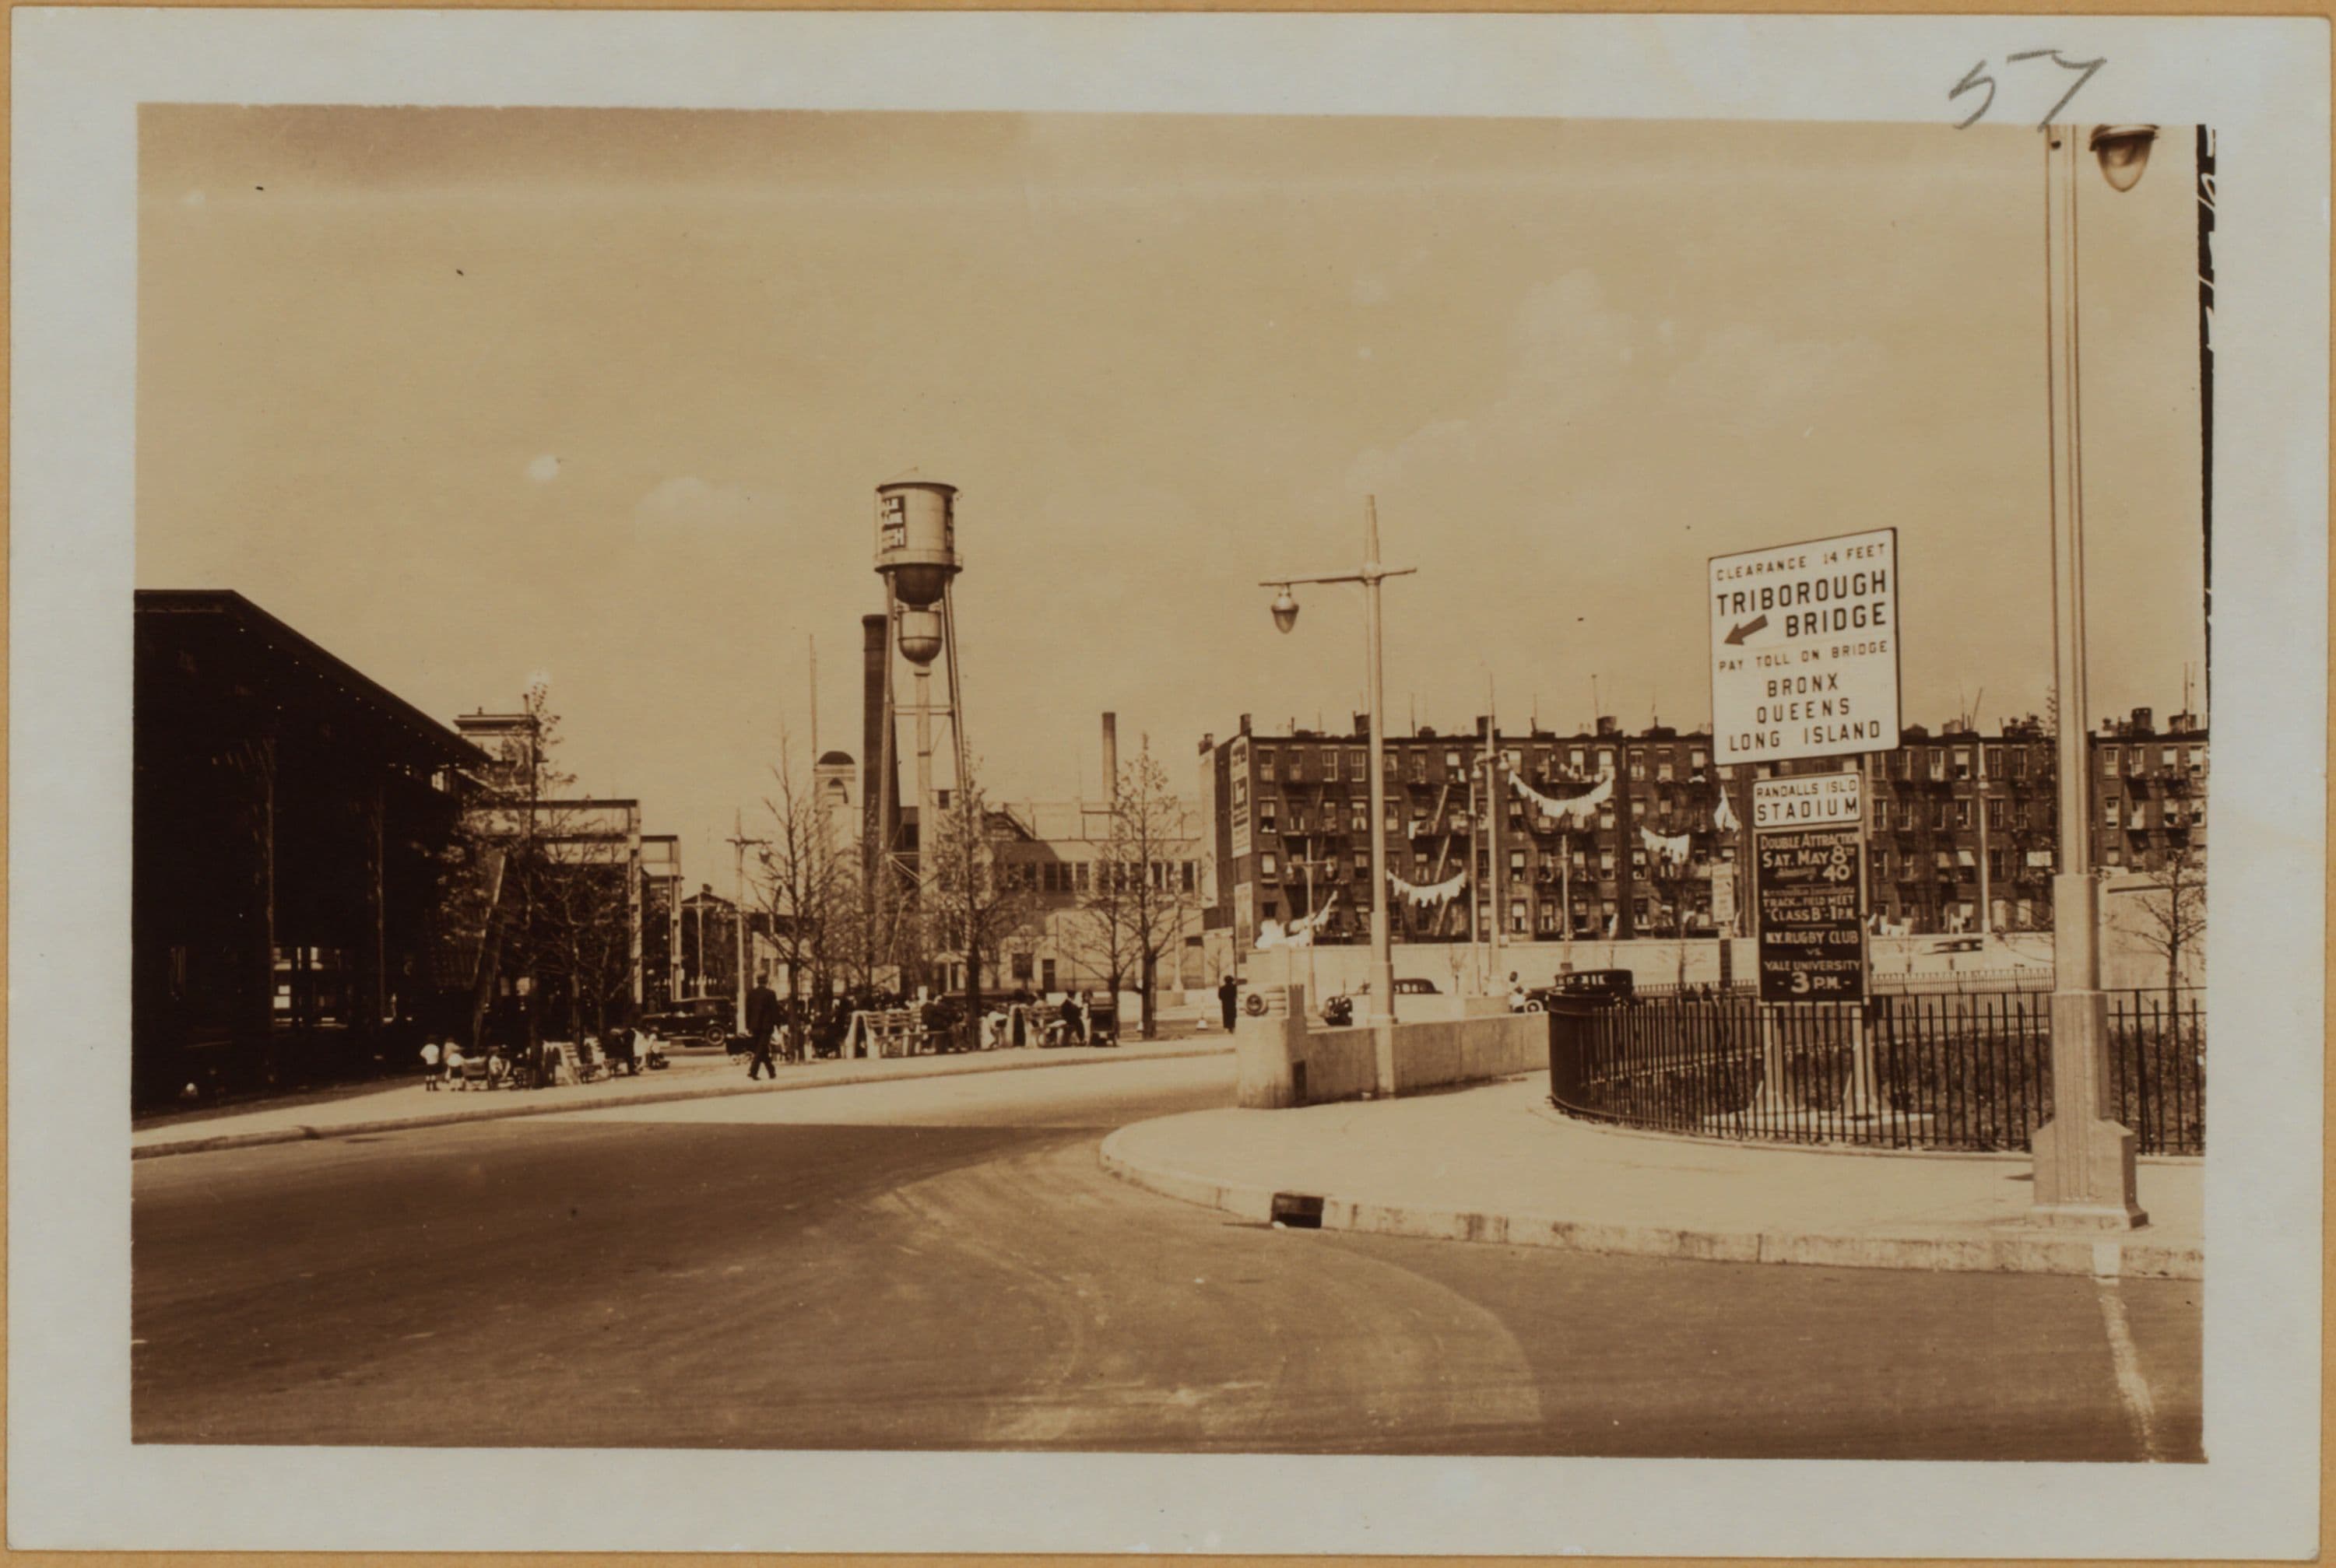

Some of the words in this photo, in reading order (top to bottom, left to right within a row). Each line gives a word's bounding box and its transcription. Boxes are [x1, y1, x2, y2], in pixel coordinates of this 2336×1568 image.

[1948, 49, 2107, 133] 57
[1716, 555, 1807, 581] CLEARANCE
[1824, 550, 1838, 565] 14
[1846, 542, 1885, 560] FEET
[1716, 569, 1887, 616] TRIBOROUGH
[1786, 601, 1887, 638] BRIDGE
[1719, 658, 1744, 673] PAY
[1755, 654, 1790, 668] TOLL
[1801, 649, 1820, 663] ON
[1832, 640, 1888, 659] BRIDGE
[1767, 672, 1839, 698] BRONX
[1757, 697, 1850, 724] QUEENS
[1730, 730, 1781, 752] LONG
[1804, 720, 1881, 745] ISLAND
[1756, 782, 1818, 798] RANDALLS
[1757, 796, 1857, 822] STADIUM
[1760, 835, 1800, 851] DOUBLE
[1762, 851, 1795, 868] SAT.
[1797, 849, 1829, 865] MAY
[1762, 896, 1795, 907] TRACK
[1803, 896, 1825, 907] FIELD
[1828, 894, 1855, 906] MEET
[1785, 931, 1825, 945] RUGBY
[1828, 930, 1859, 945] CLUB
[1764, 960, 1790, 972] YALE
[1793, 959, 1862, 972] UNIVERSITY
[1790, 970, 1811, 994] 3
